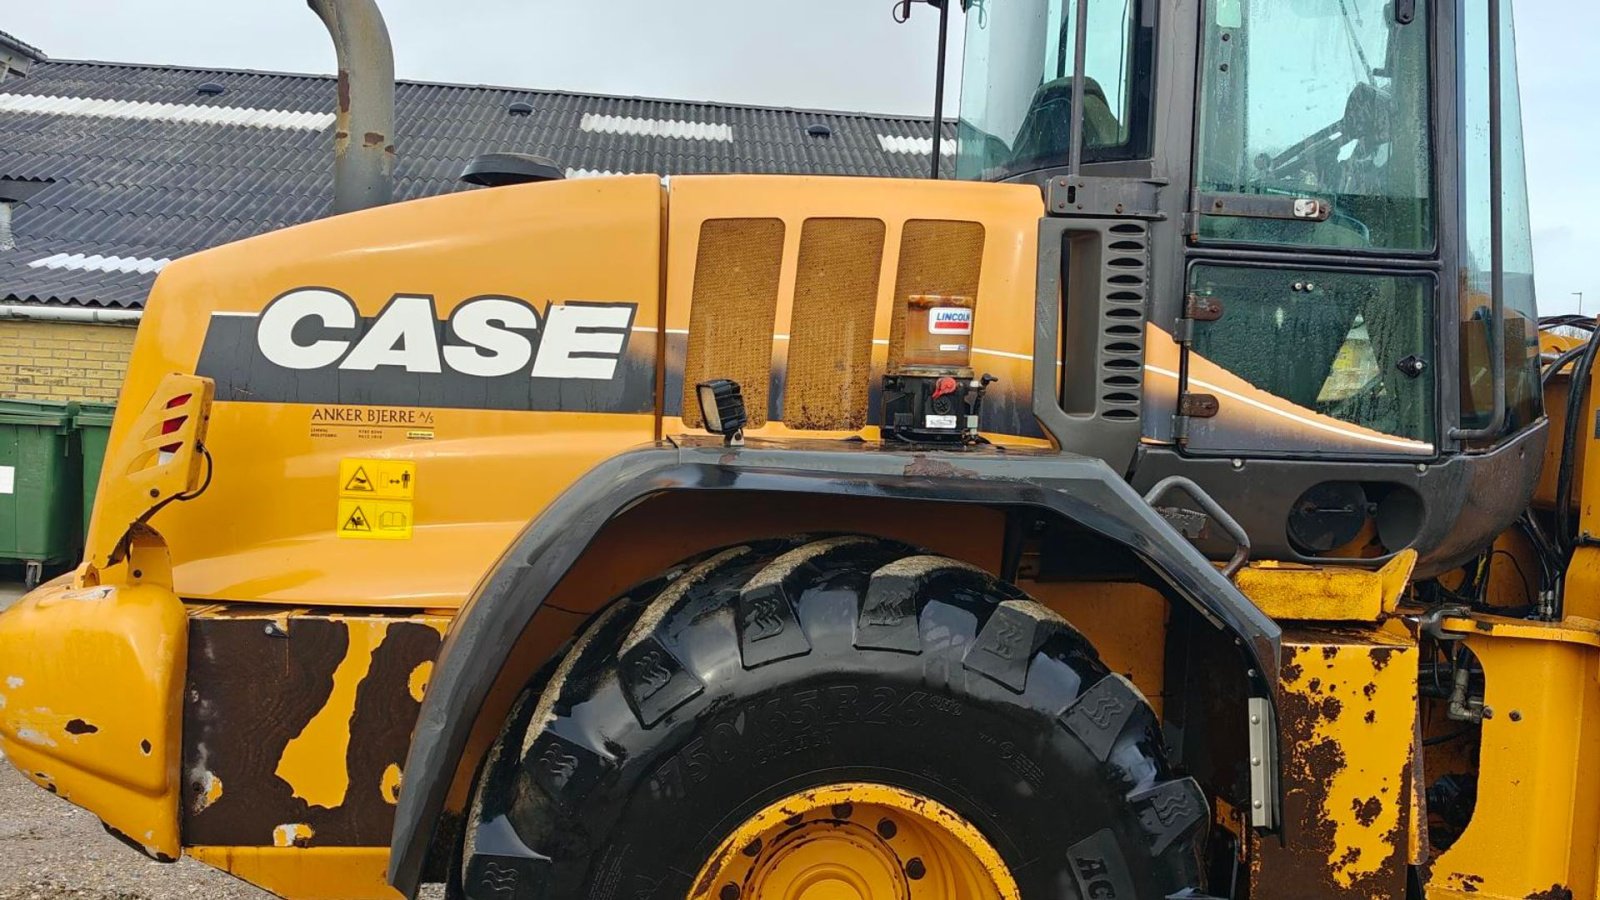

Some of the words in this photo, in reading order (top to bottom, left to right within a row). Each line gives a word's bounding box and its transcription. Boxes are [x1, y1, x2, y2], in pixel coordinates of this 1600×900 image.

[257, 288, 635, 380] CASE
[311, 408, 363, 422] ANKER
[367, 410, 416, 424] BJERRE
[418, 411, 434, 424] A/S
